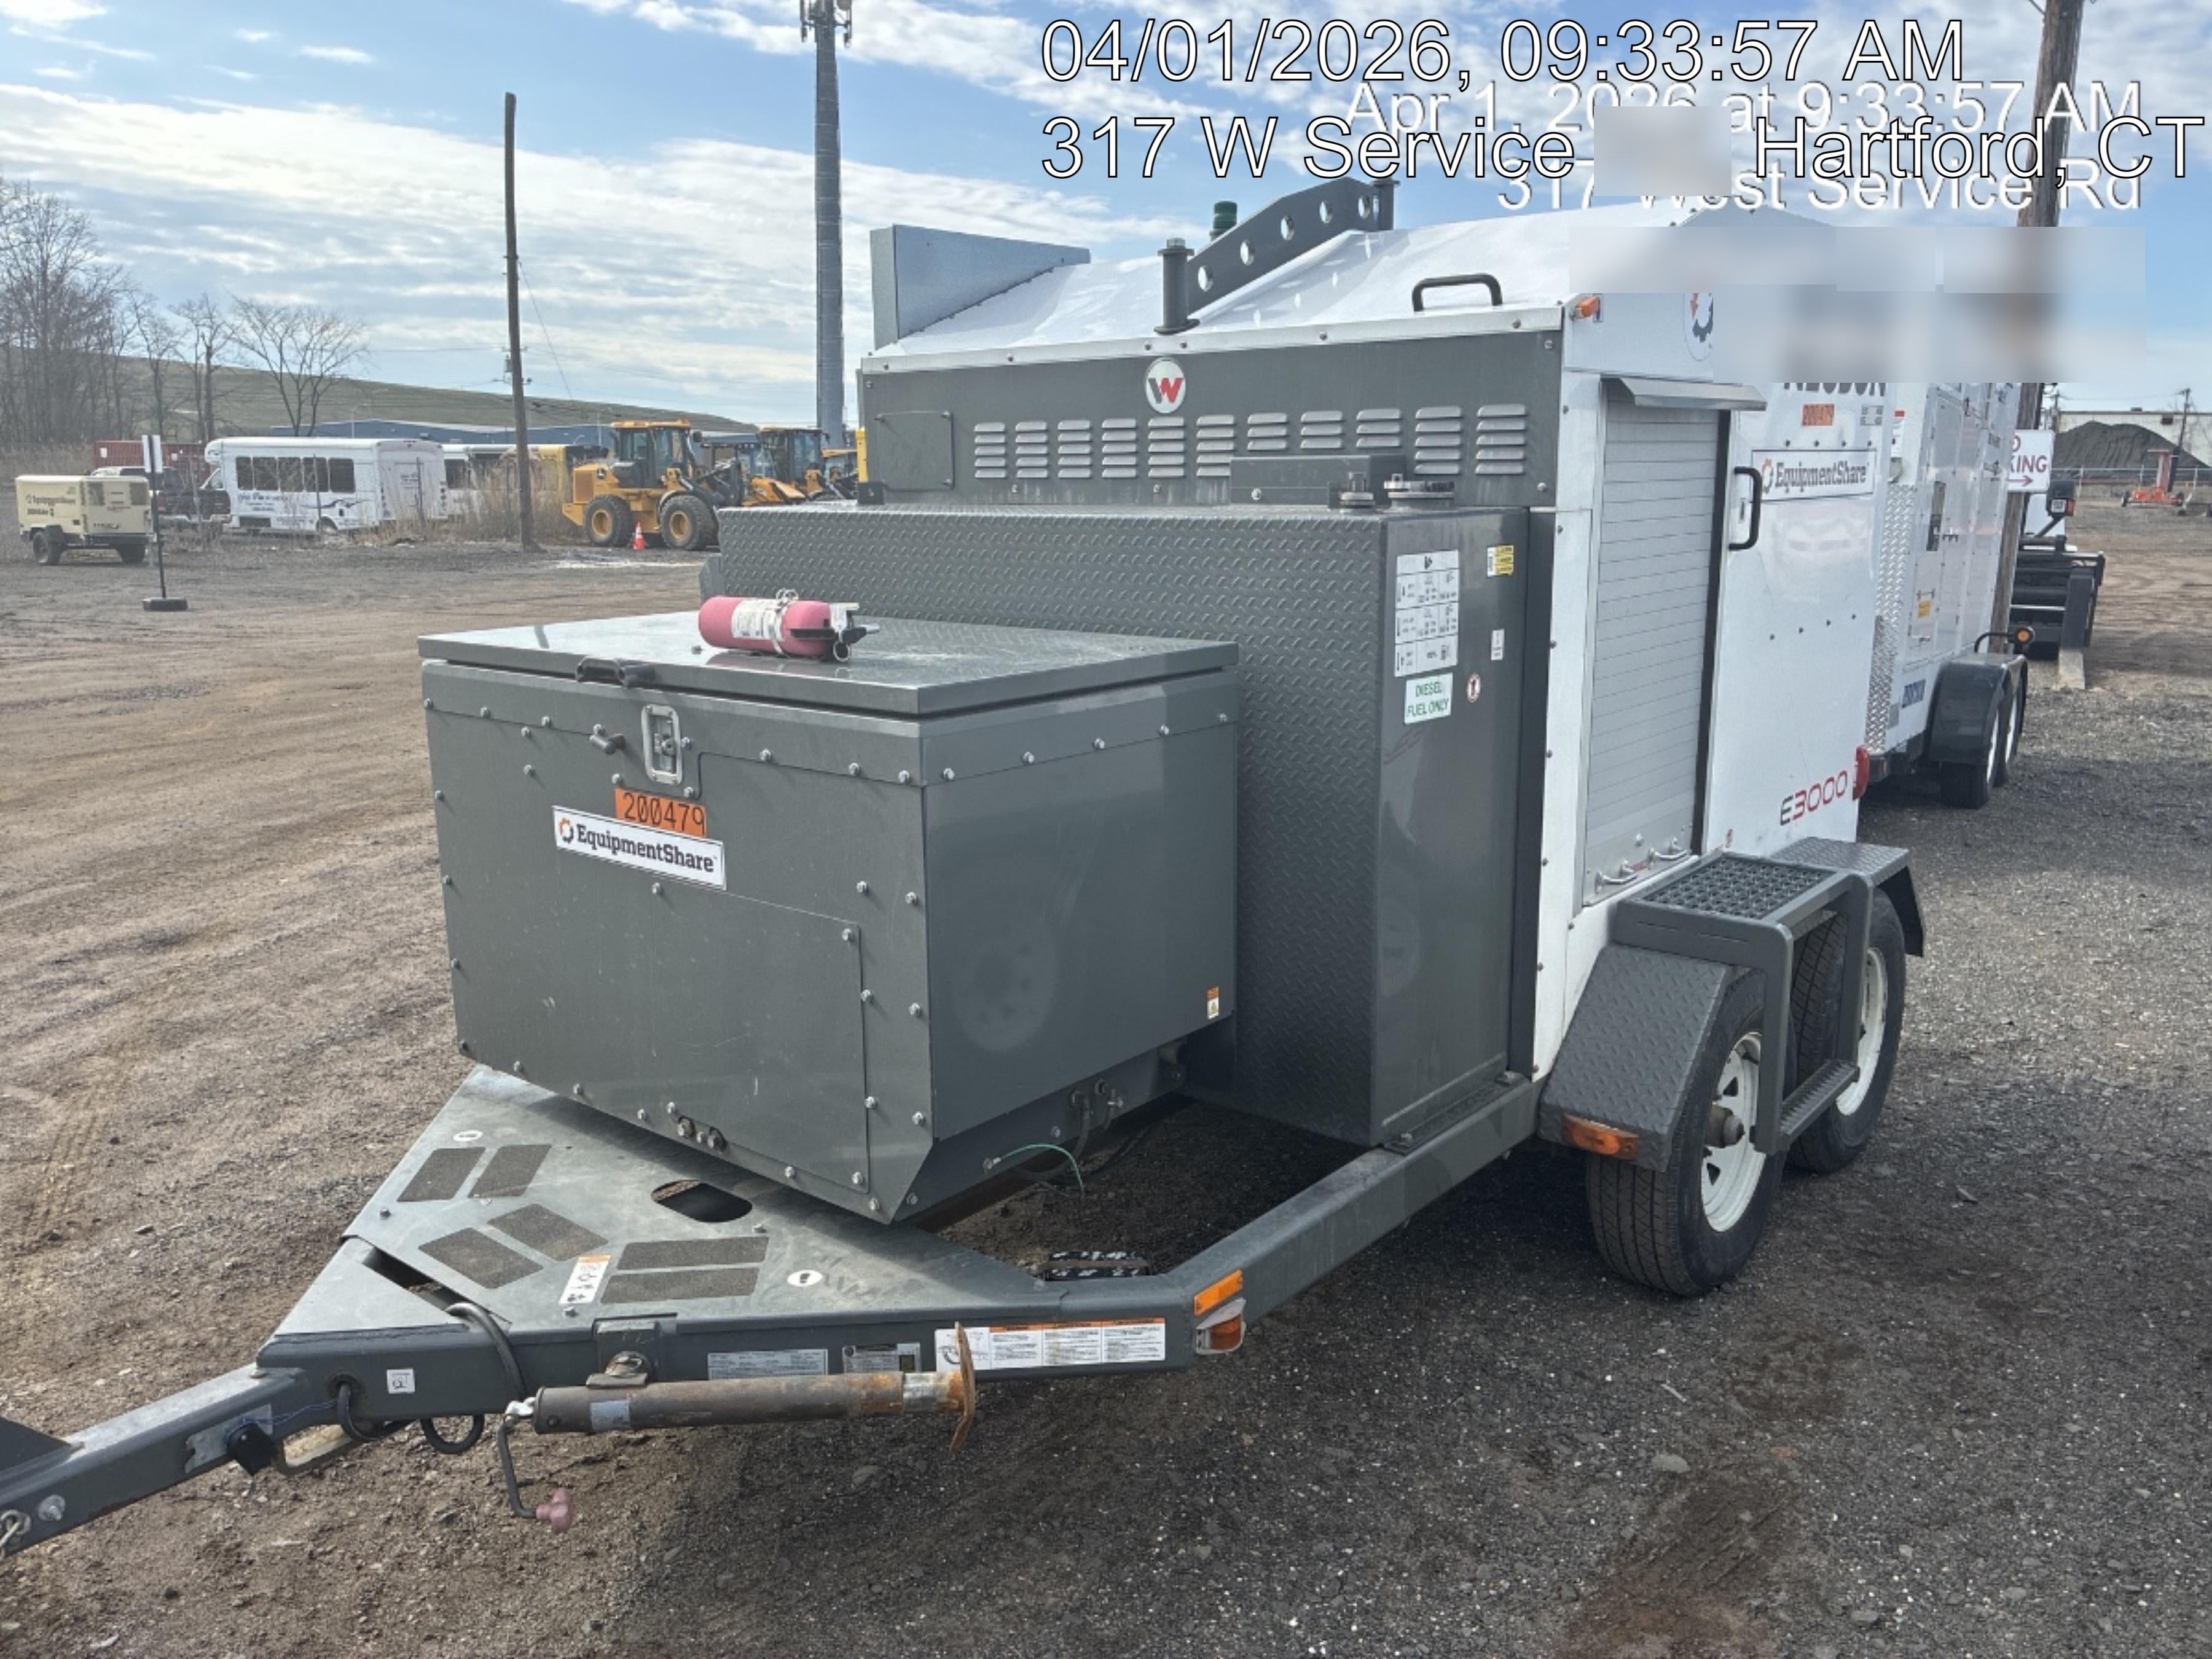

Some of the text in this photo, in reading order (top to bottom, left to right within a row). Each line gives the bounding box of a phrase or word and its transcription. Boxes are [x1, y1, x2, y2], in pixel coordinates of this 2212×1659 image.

[1775, 460, 1867, 493] EquipmentShare
[1407, 698, 1449, 718] FUEL ONLY
[1416, 681, 1443, 697] DIESEL
[623, 791, 705, 836] 200479
[1779, 769, 1848, 826] E3000
[576, 823, 715, 873] EquipmentShare
